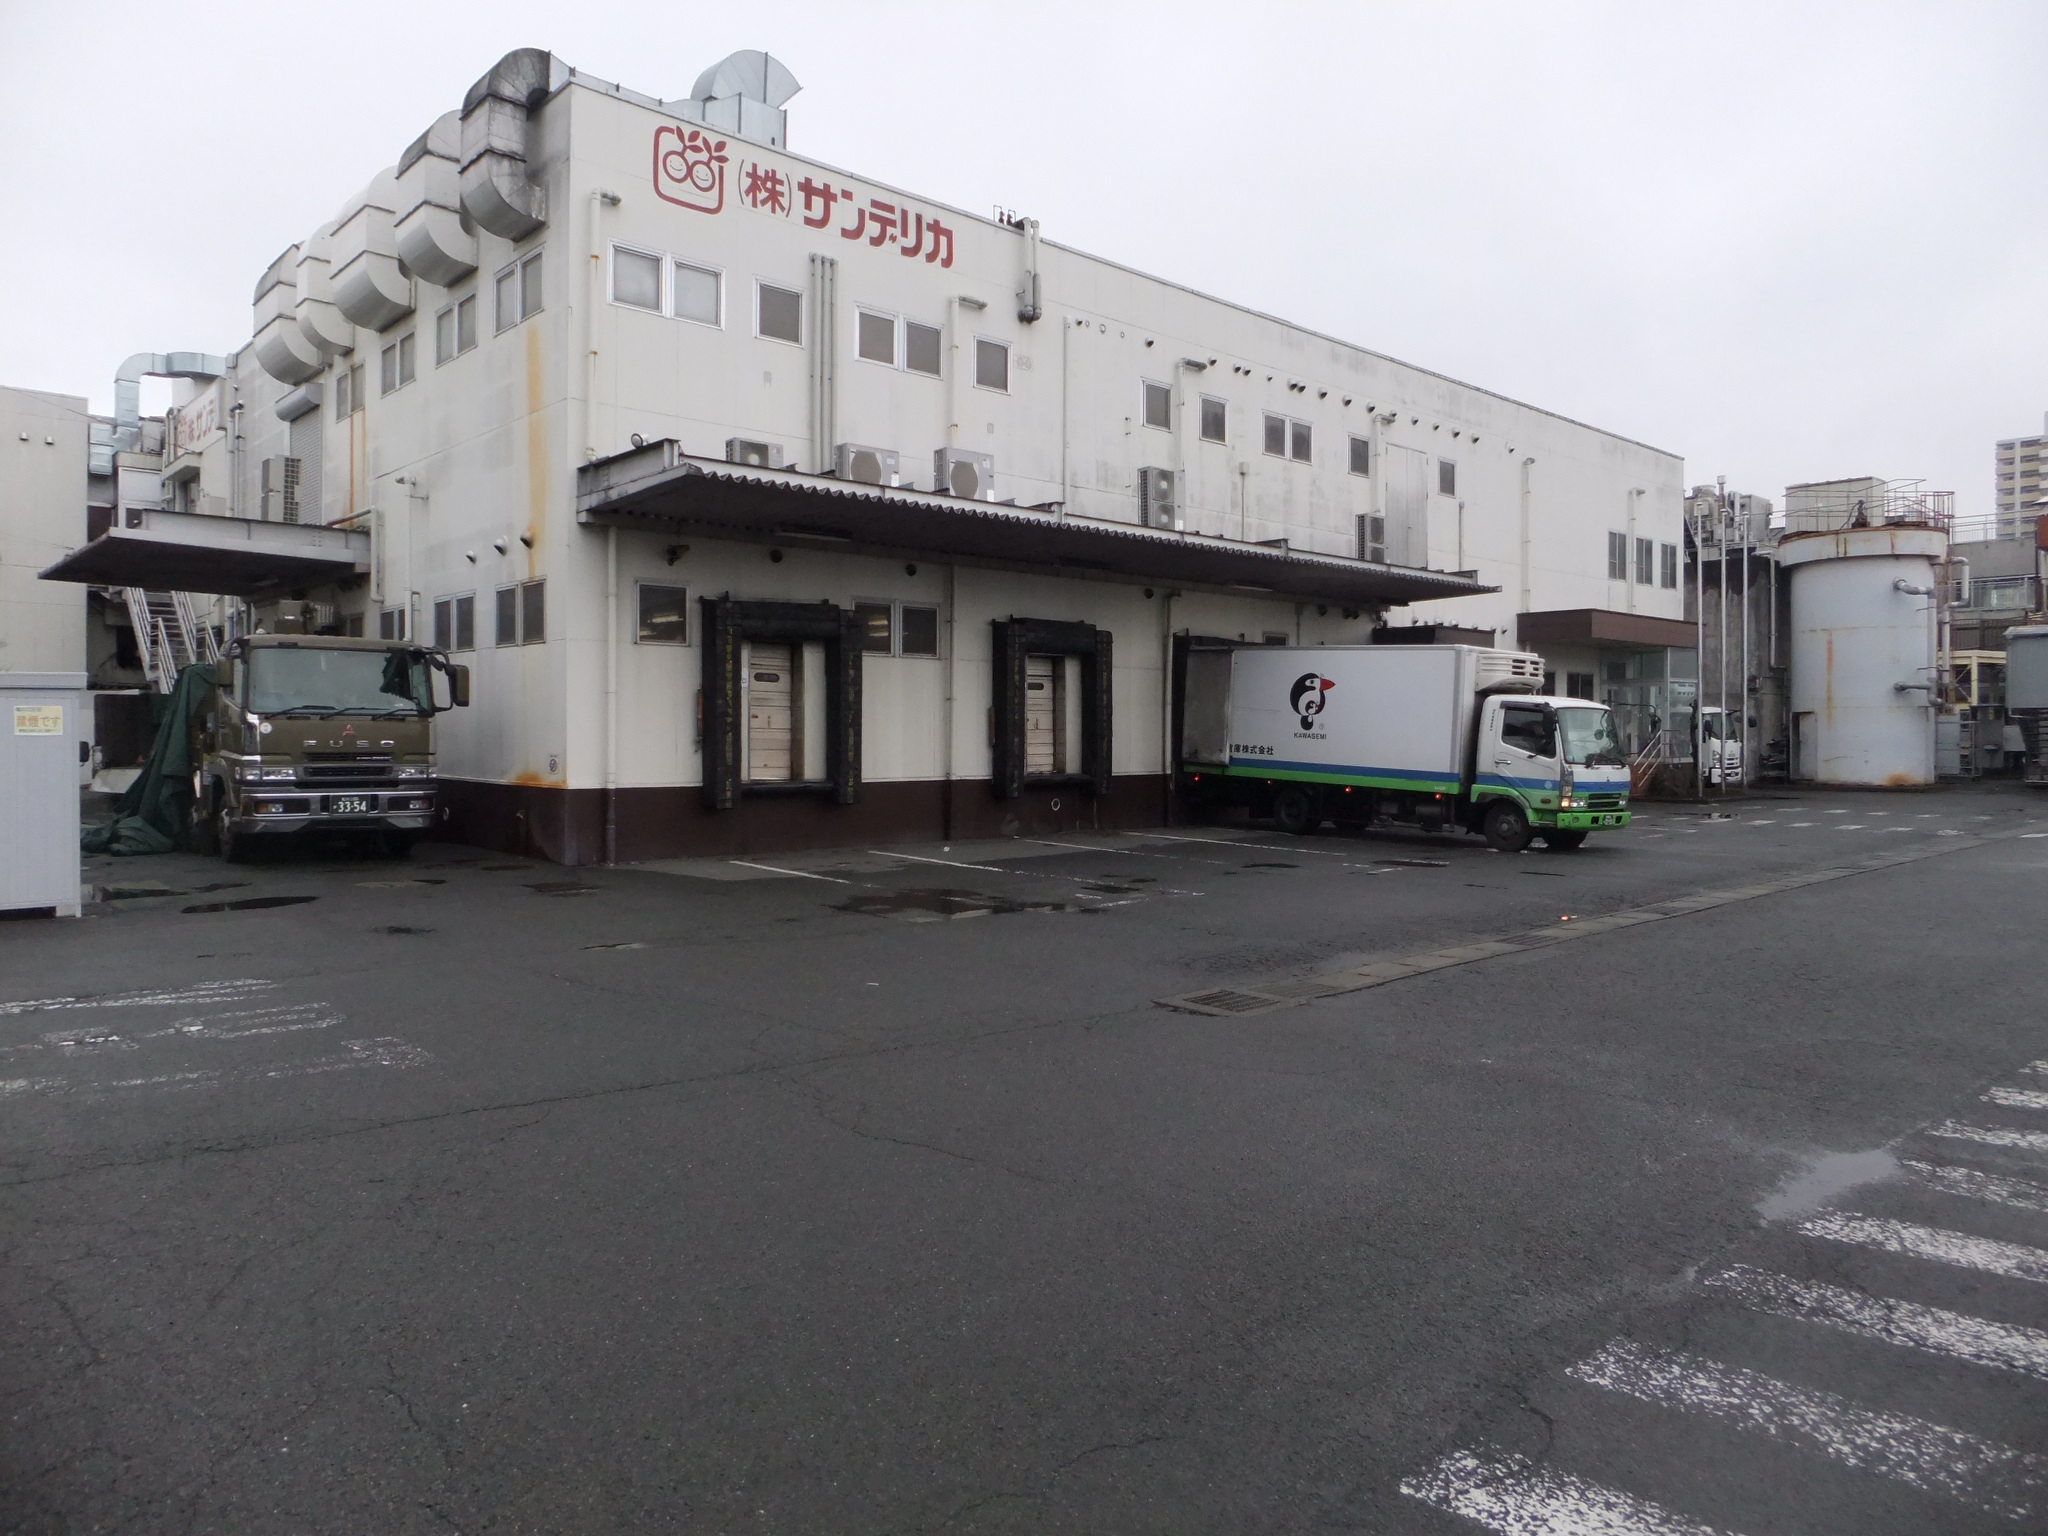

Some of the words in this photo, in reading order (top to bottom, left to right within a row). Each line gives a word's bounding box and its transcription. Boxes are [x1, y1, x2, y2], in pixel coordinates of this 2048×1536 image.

[738, 158, 953, 269] (株)サンデリカ
[1293, 732, 1327, 740] KAWASEMI
[303, 740, 395, 748] FUSO
